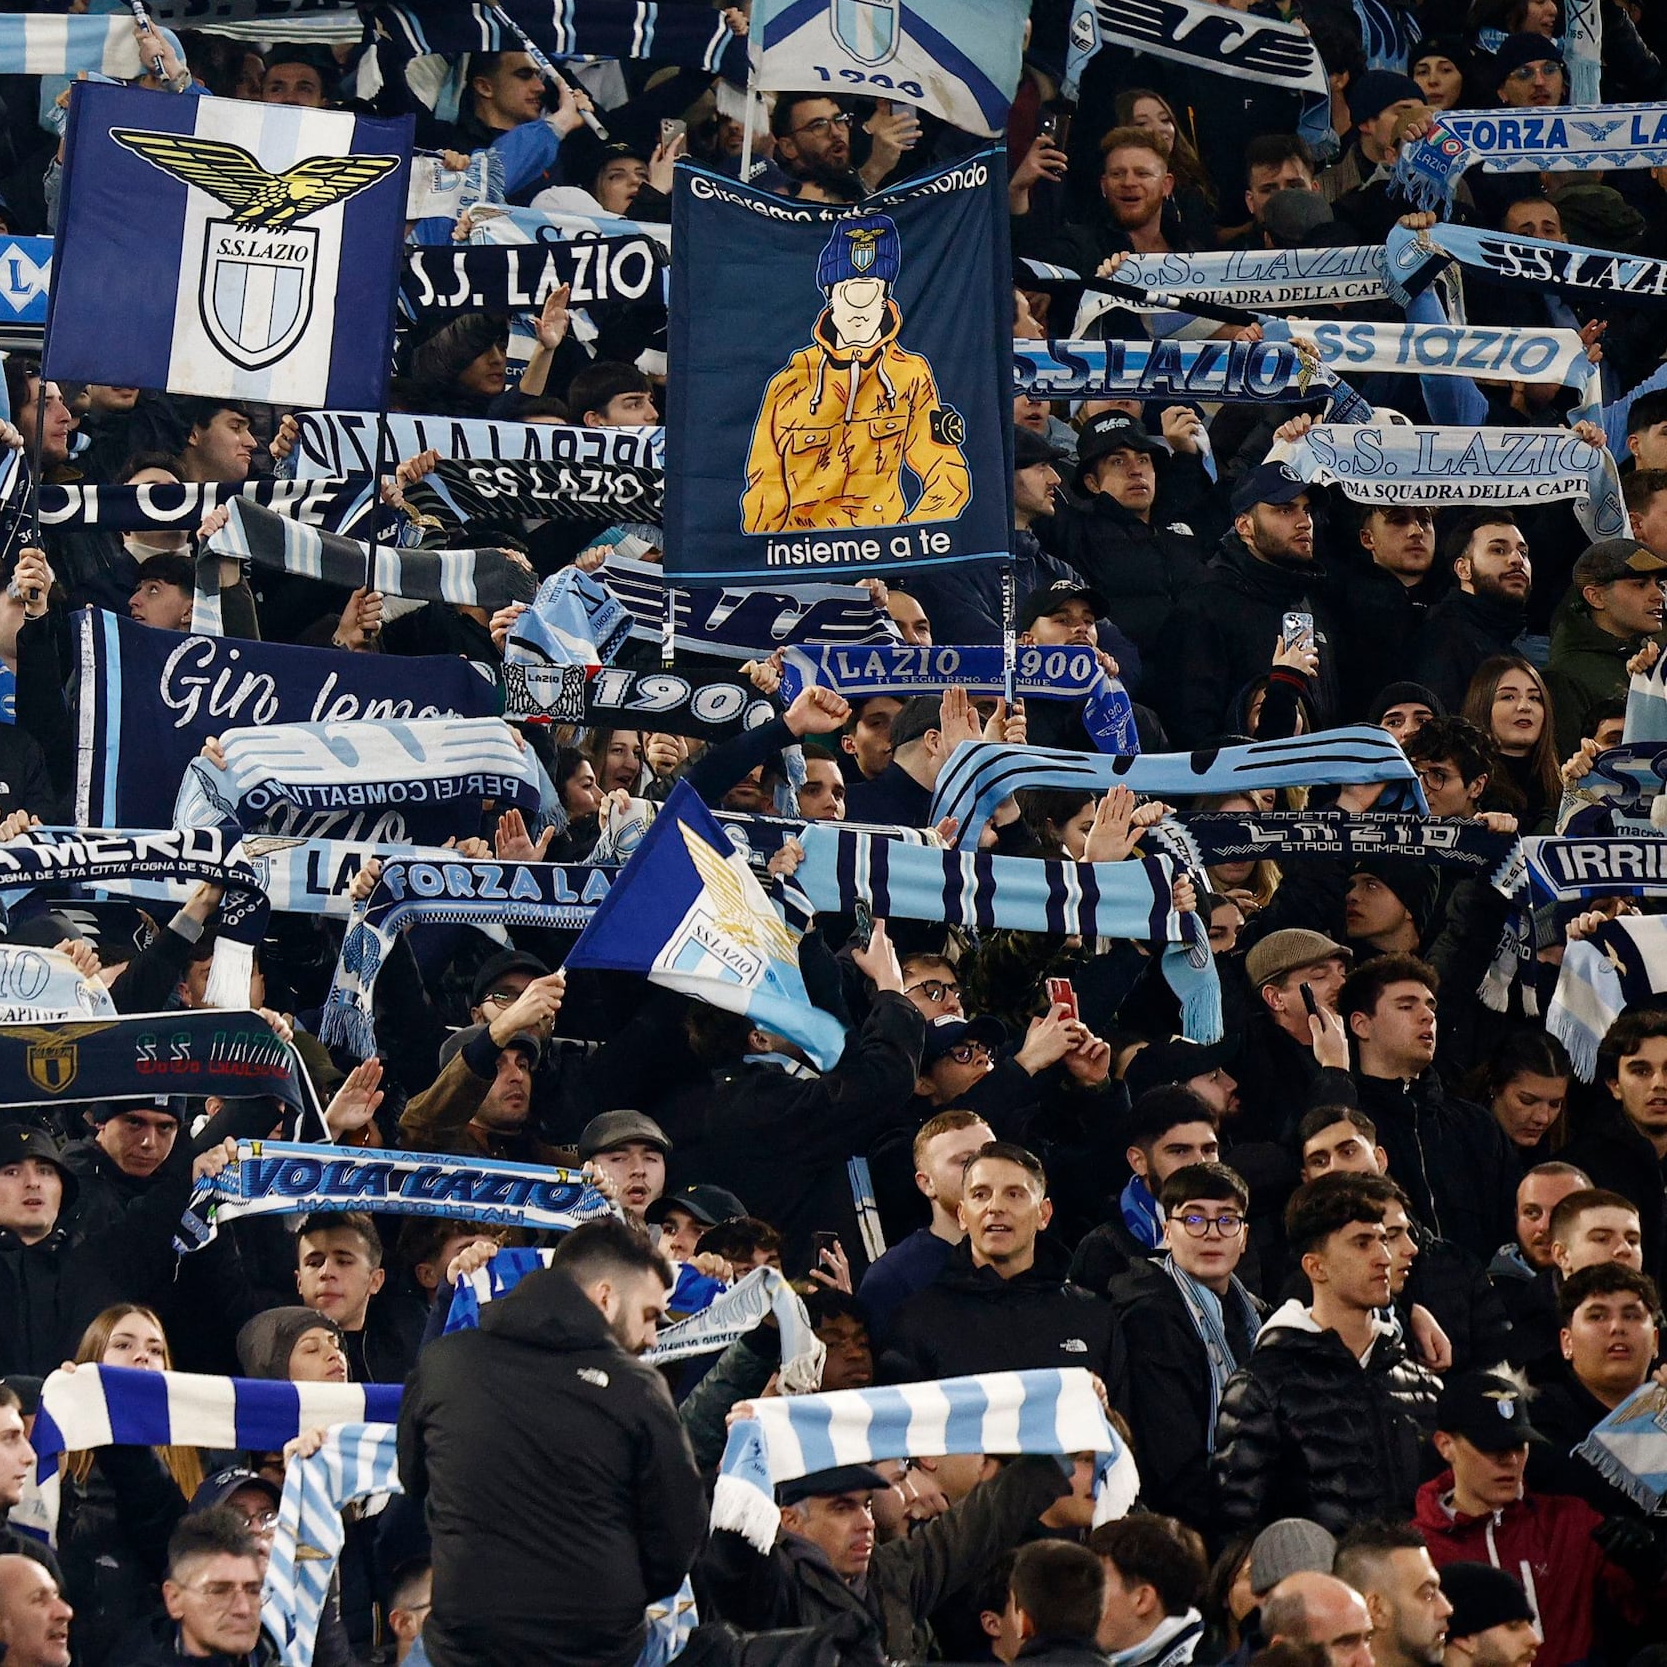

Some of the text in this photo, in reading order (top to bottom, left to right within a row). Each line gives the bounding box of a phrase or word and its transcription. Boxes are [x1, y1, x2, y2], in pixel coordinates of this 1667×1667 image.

[1452, 119, 1569, 151] FORZA
[217, 237, 310, 264] S.S. LAZIO
[506, 239, 656, 307] LAZIO
[1185, 285, 1341, 308] SQUADRA DELLA
[1316, 321, 1561, 376] ss lazio
[1118, 339, 1291, 400] LAZIO
[1310, 427, 1601, 477] S.S. LAZIO
[468, 466, 643, 505] SS LAZIO
[1373, 482, 1532, 501] SQUADRA DELLA
[764, 527, 951, 567] insieme a te
[160, 635, 280, 730] Gin
[838, 651, 960, 682] LAZIO
[895, 674, 982, 687] SEGUIREMO
[1247, 819, 1460, 849] LAZIO
[1348, 812, 1443, 826] SPORTIVA
[1279, 839, 1427, 857] STADIO OLIMPICO
[381, 862, 547, 903] FORZA
[238, 1157, 585, 1214] VOLA LAZIO
